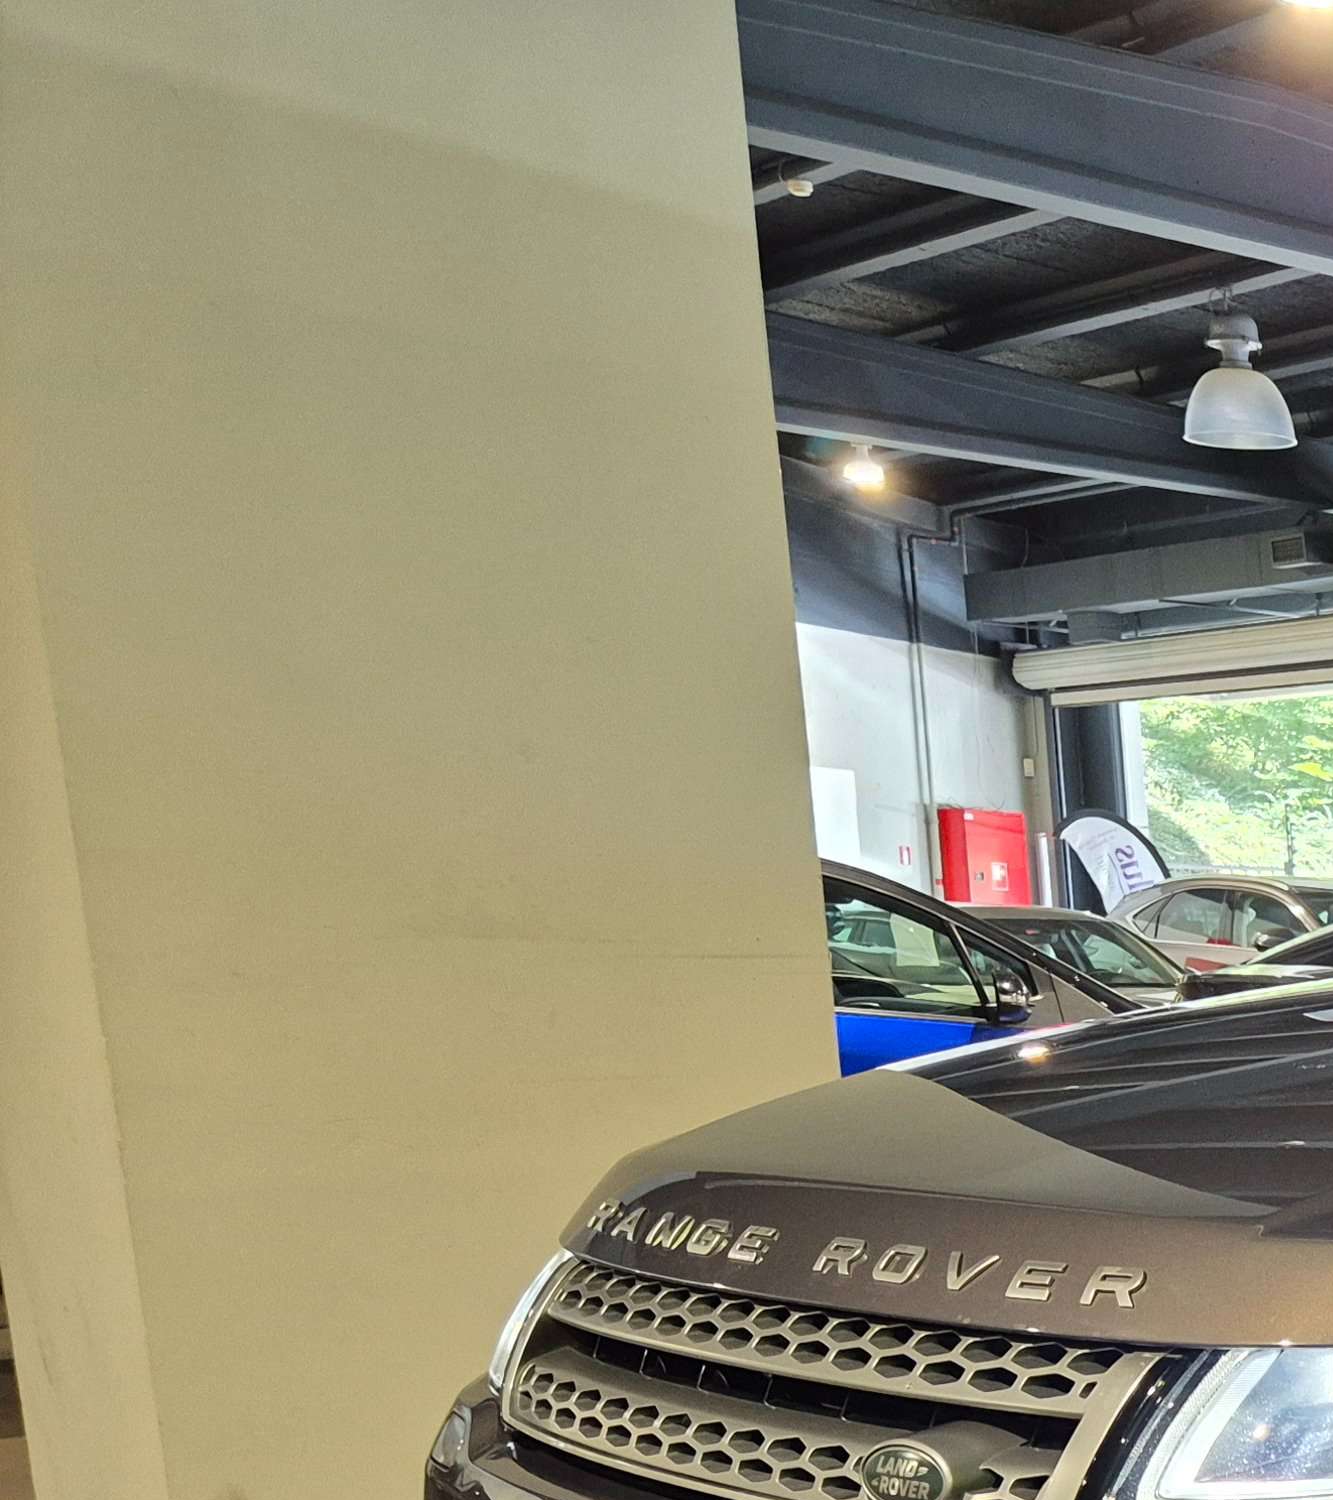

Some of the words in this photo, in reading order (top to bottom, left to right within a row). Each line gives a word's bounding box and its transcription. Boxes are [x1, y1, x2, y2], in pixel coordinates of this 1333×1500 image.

[586, 1200, 780, 1264] RANGE
[812, 1236, 1148, 1308] ROVER
[876, 1455, 919, 1478] LAND
[879, 1475, 930, 1500] ROVER
